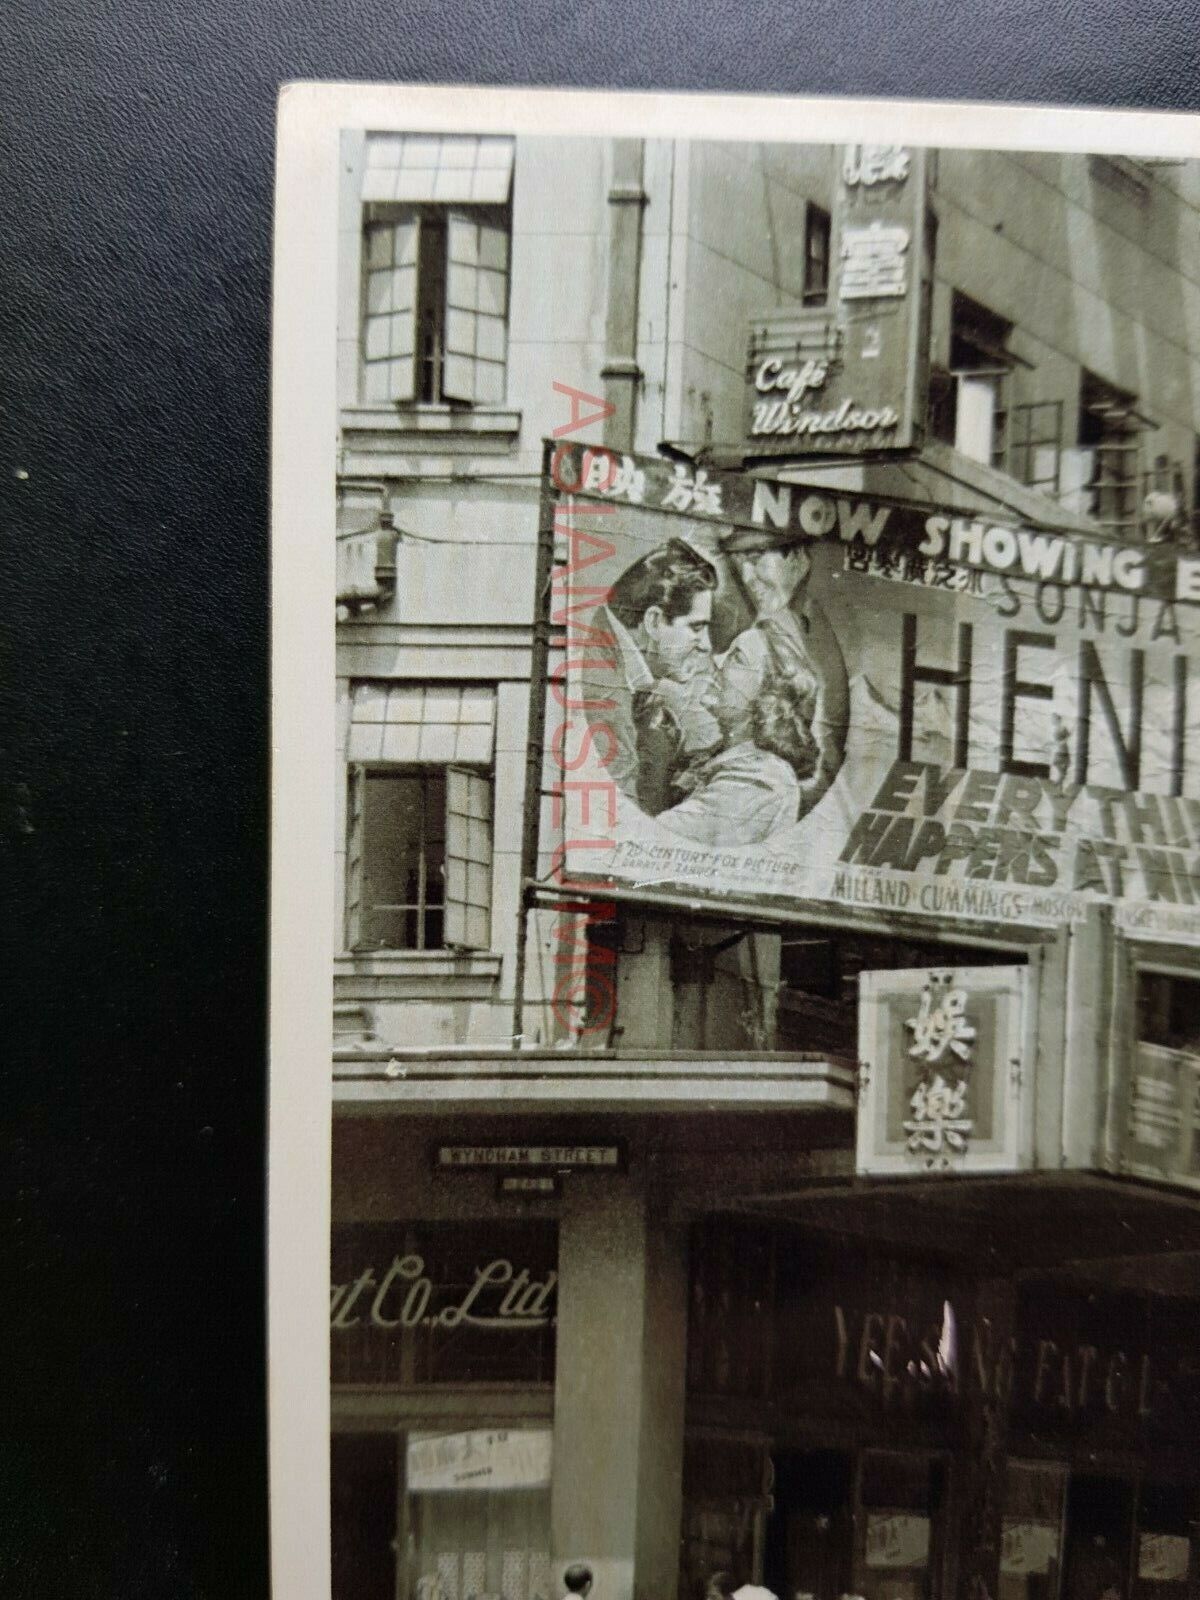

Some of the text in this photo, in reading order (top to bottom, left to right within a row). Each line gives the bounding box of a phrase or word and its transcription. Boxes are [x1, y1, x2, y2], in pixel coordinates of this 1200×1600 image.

[751, 396, 899, 435] Windsor
[751, 481, 892, 546] NOW
[919, 515, 1147, 591] SHOWING
[992, 575, 1181, 645] SONJA
[837, 811, 1062, 888] HAPPENS
[1136, 847, 1200, 906] NI
[830, 871, 911, 908] MILLAND
[919, 883, 1024, 919] CUMMINGS
[541, 1147, 608, 1164] STREET
